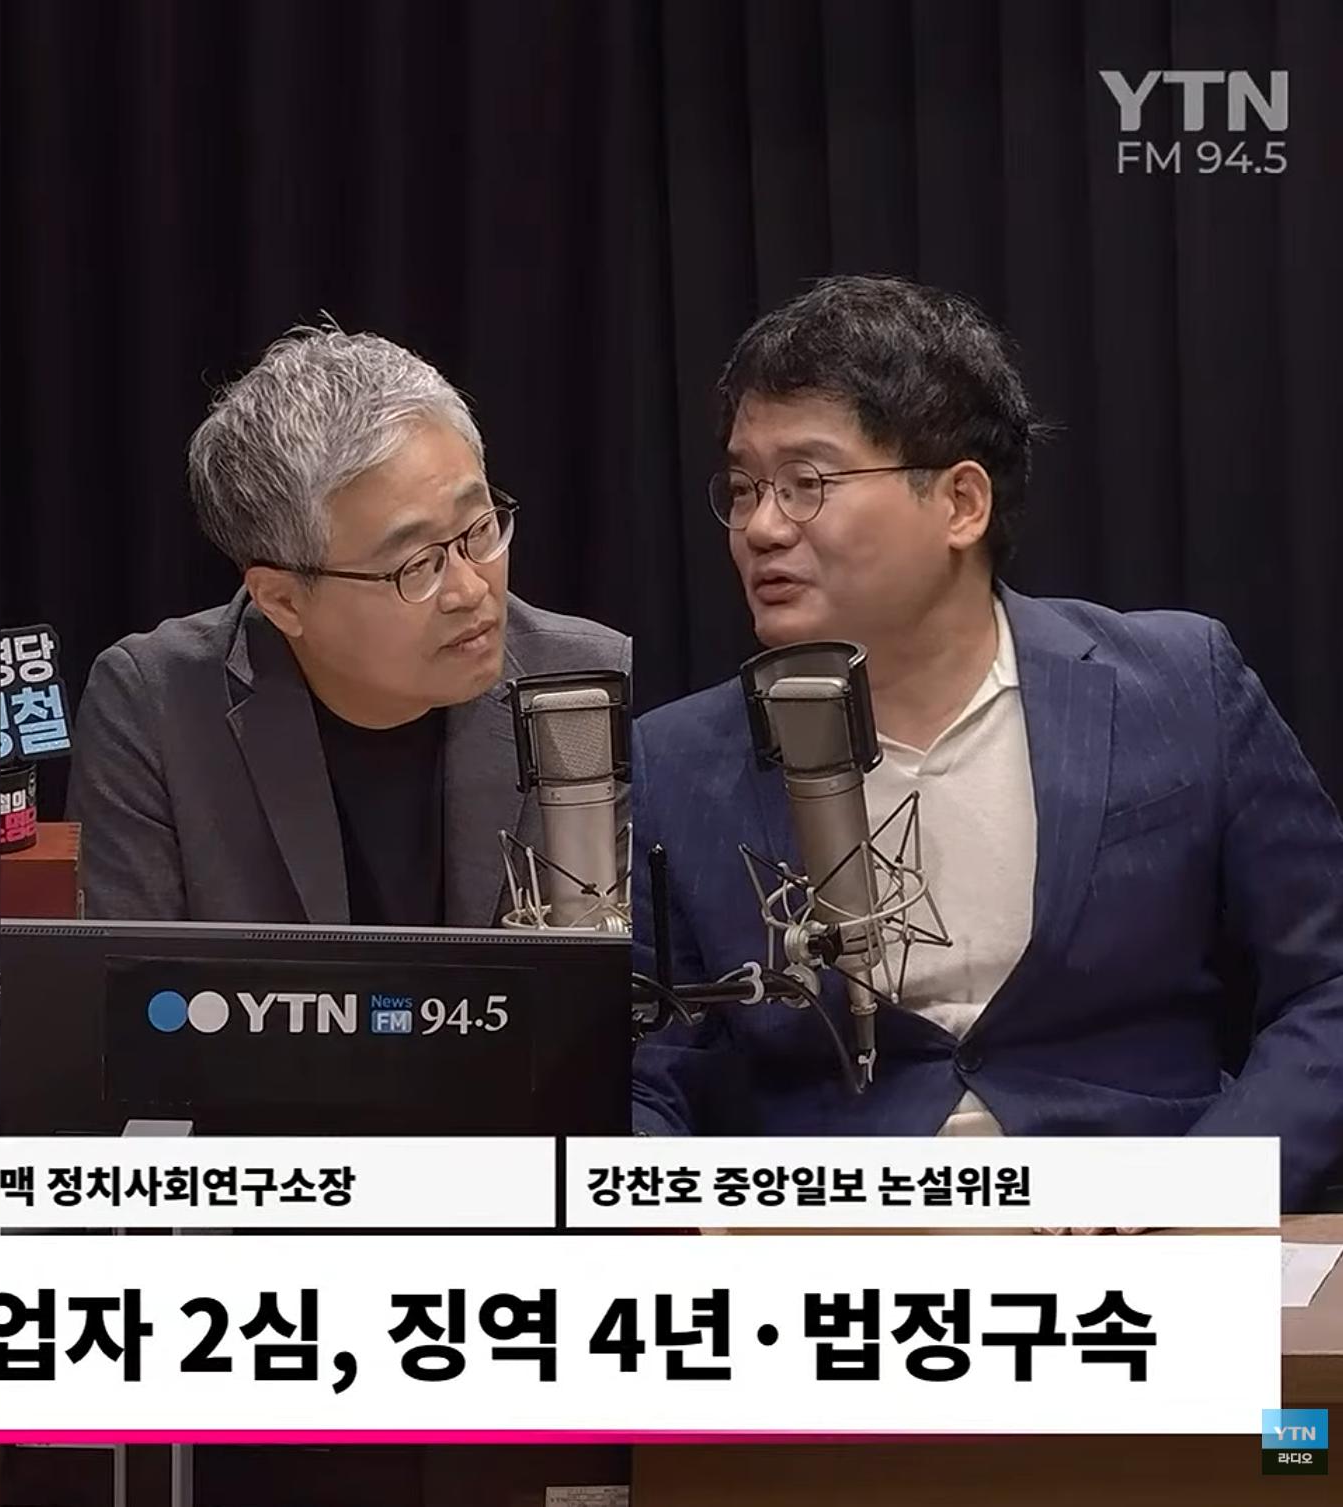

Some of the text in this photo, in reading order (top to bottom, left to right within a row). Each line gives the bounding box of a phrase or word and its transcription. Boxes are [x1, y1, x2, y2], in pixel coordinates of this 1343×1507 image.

[237, 992, 357, 1034] YTN
[371, 994, 413, 1009] News
[420, 995, 509, 1036] 94.5
[377, 1011, 410, 1032] FM
